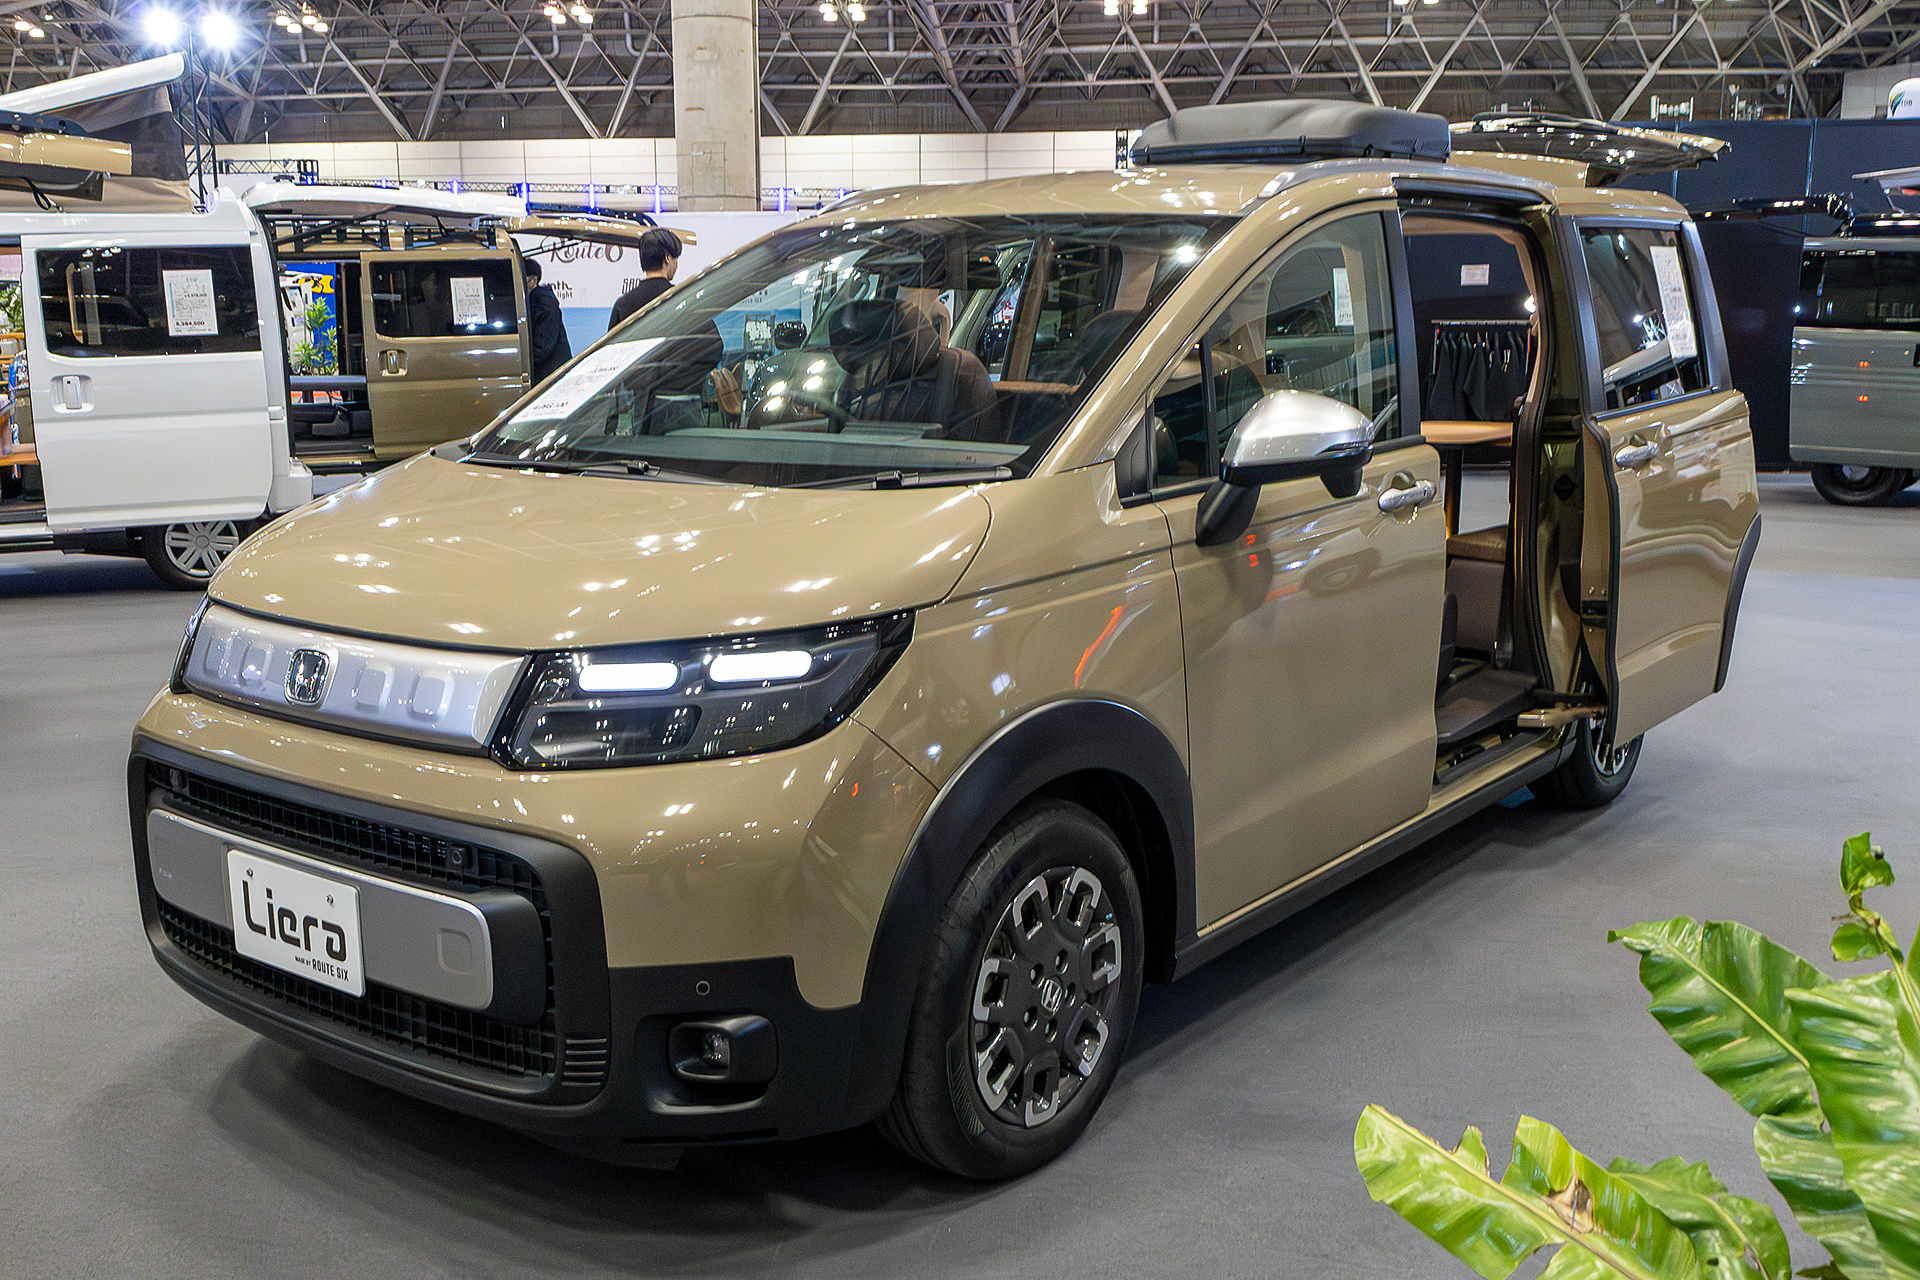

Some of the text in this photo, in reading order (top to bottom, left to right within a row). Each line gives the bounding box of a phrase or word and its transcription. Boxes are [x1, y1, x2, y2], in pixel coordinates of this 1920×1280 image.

[242, 879, 347, 963] Liera
[312, 958, 335, 977] ROUTE
[336, 966, 350, 982] SIX
